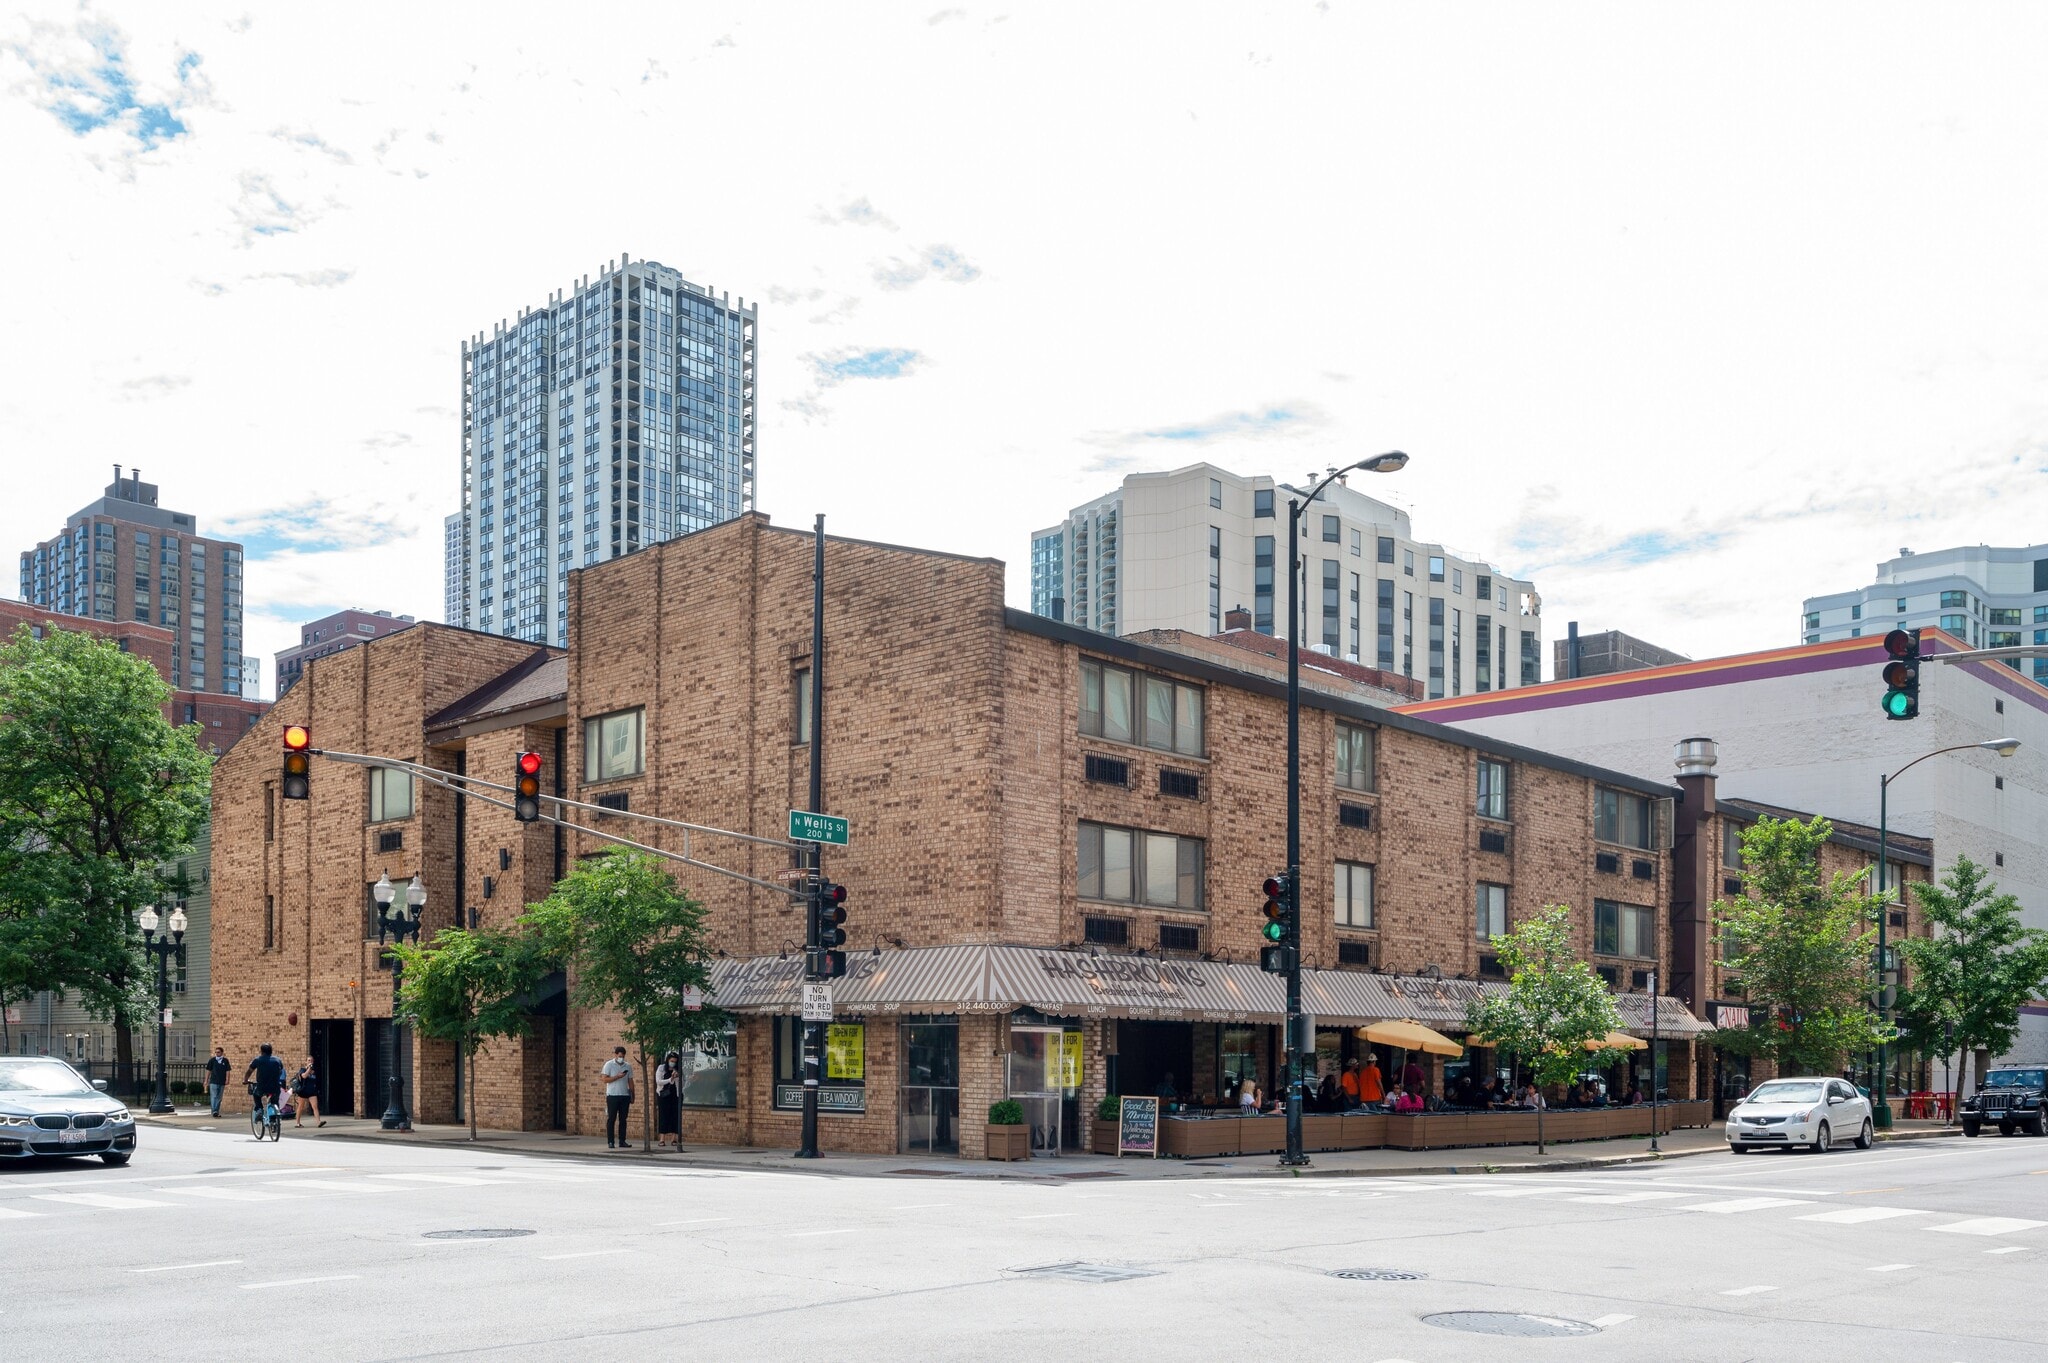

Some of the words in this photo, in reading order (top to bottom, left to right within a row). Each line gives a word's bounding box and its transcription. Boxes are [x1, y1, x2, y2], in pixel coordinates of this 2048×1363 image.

[804, 816, 832, 830] Wells
[836, 824, 843, 832] St
[807, 829, 822, 838] 200
[721, 957, 879, 984] HASHBNS
[1038, 956, 1206, 987] HASHBROWNS
[1088, 984, 1140, 998] Breakfast
[1141, 988, 1185, 1001] Anytime!
[1725, 1008, 1748, 1028] NAILS
[834, 1028, 848, 1037] OPEN
[849, 1028, 858, 1037] FOR
[1052, 1035, 1065, 1044] OPN
[1067, 1036, 1077, 1045] FOR
[785, 1092, 803, 1101] COFFE
[823, 1093, 834, 1103] TEA
[834, 1093, 858, 1103] WINDOW
[1124, 1100, 1144, 1110] Good
[1126, 1110, 1154, 1121] Morning
[1123, 1122, 1154, 1134] Welcome
